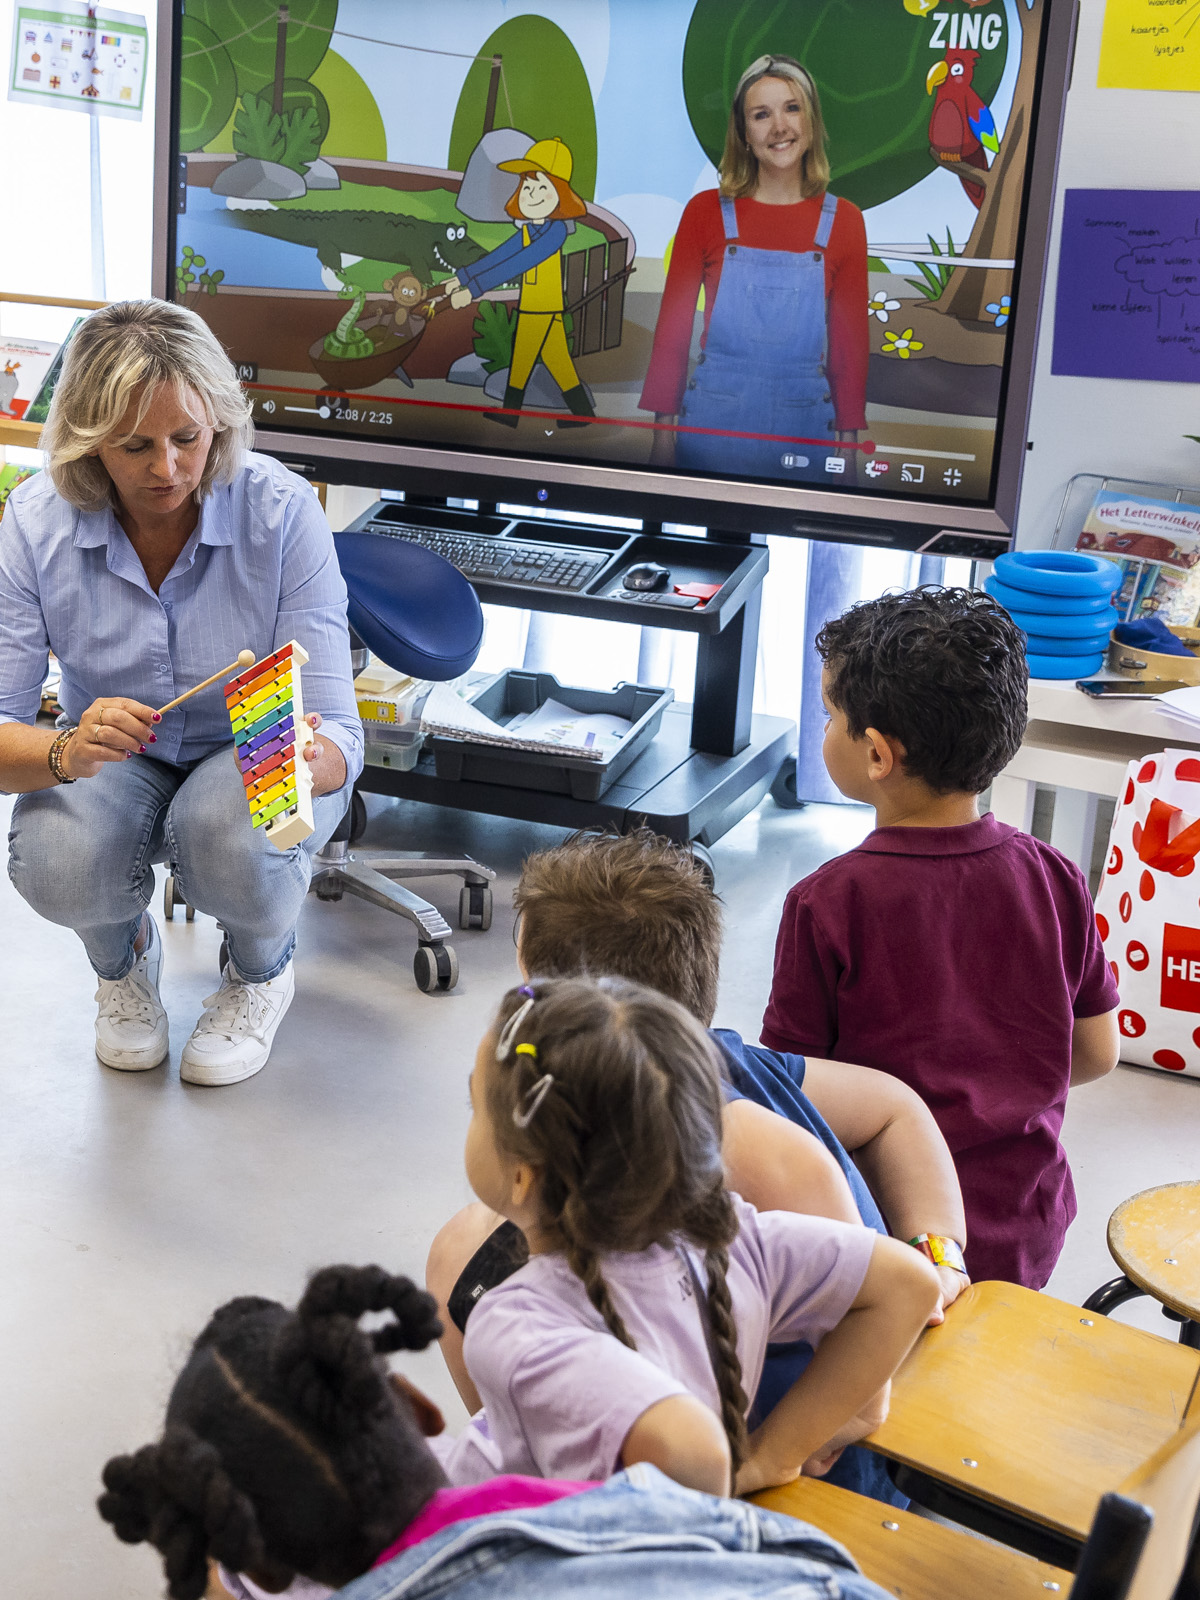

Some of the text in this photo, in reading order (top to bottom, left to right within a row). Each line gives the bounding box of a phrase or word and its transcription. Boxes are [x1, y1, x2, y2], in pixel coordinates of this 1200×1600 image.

[929, 13, 1002, 50] ZING
[238, 365, 254, 381] (k)
[335, 408, 393, 425] 2:08 / 2:25
[875, 463, 888, 472] HD
[1100, 507, 1120, 517] Het
